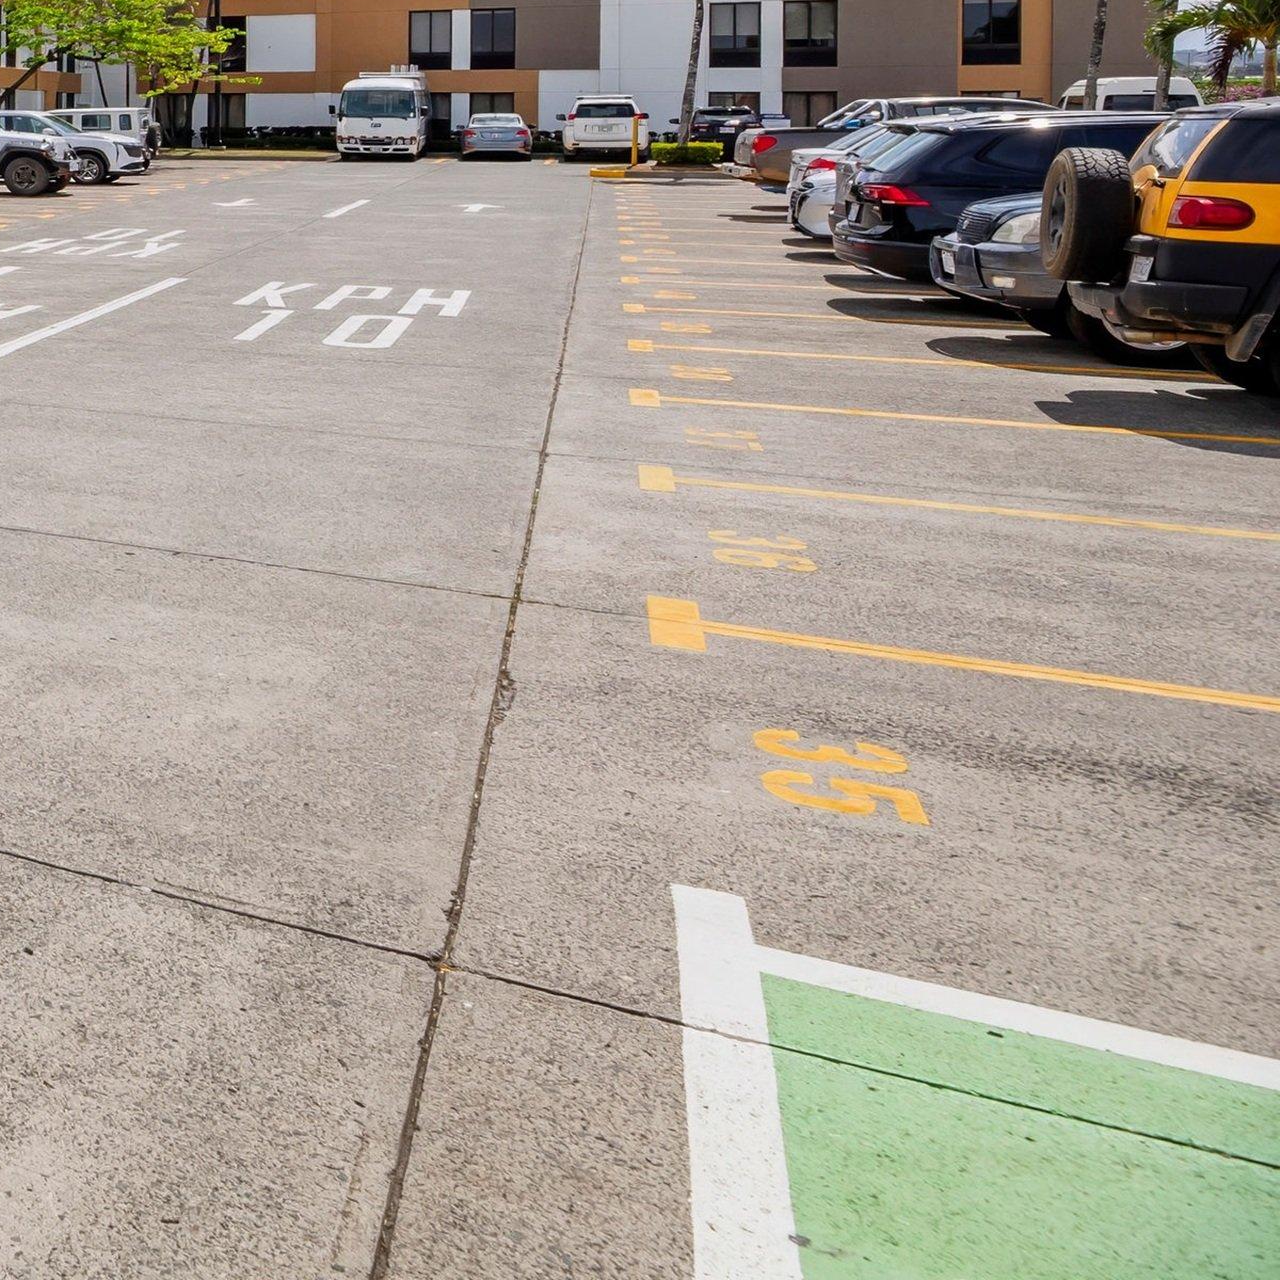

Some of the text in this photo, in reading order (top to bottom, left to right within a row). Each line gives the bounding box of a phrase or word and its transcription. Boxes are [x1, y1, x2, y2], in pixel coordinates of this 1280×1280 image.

[232, 281, 472, 317] KPH
[232, 310, 414, 349] 10
[707, 530, 818, 572] 36
[752, 728, 931, 826] 35
